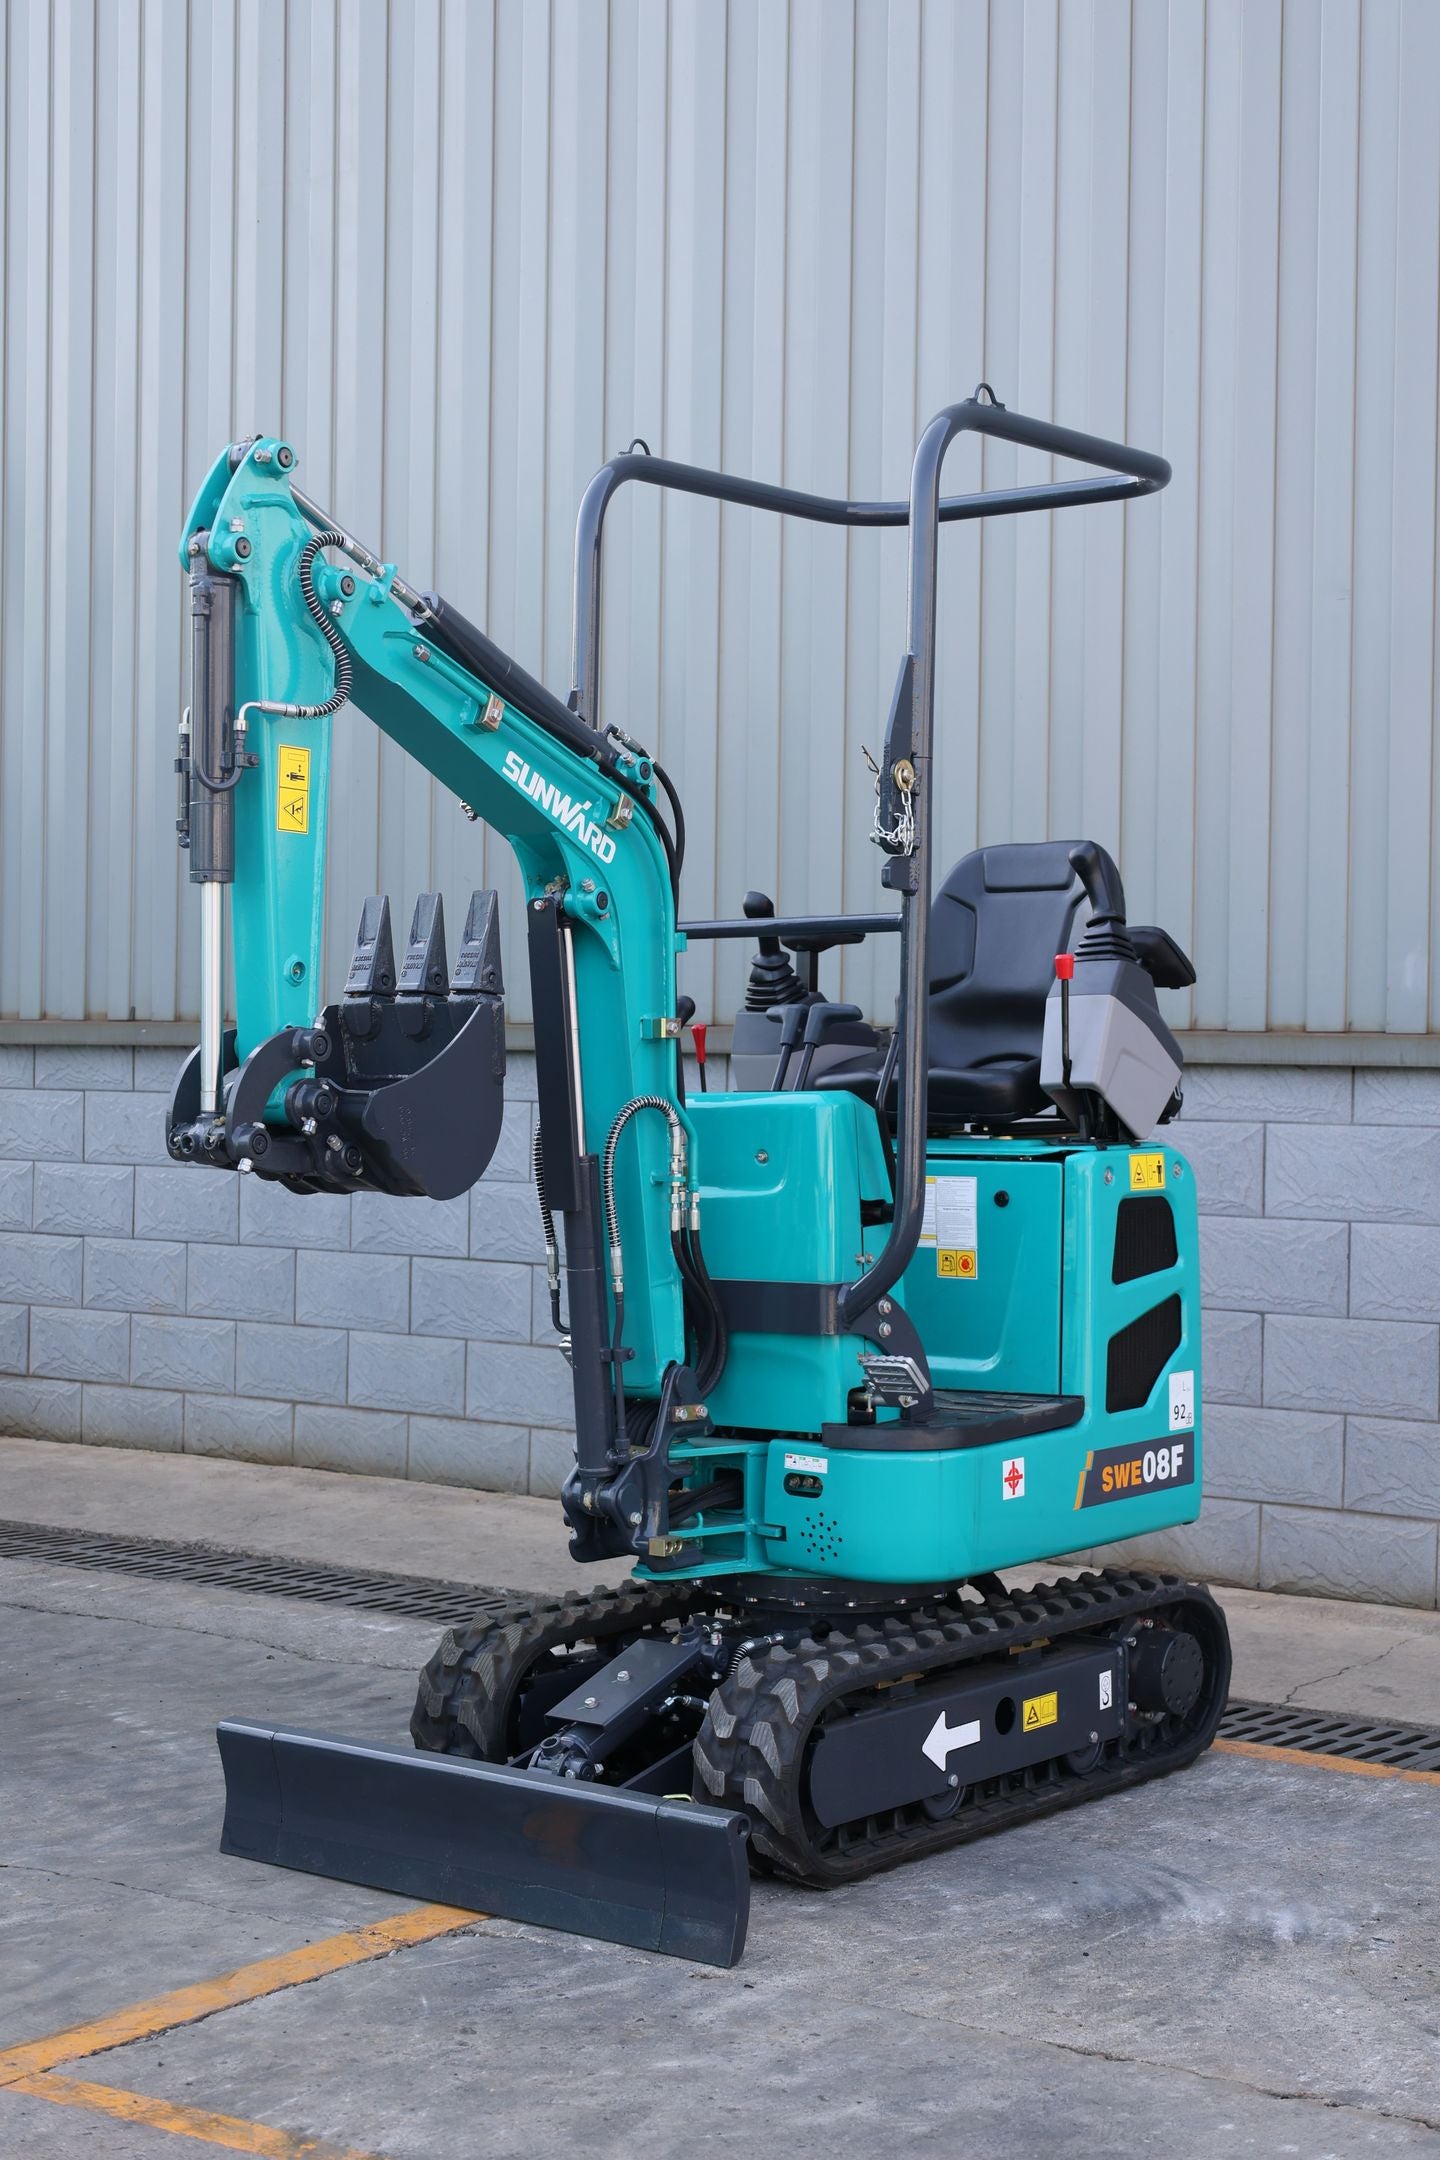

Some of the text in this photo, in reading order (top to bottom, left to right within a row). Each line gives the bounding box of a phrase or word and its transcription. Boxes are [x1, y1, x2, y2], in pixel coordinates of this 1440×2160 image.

[503, 751, 616, 864] SUNWARD
[1174, 1404, 1186, 1421] 92
[1102, 1444, 1184, 1492] SWE08F
